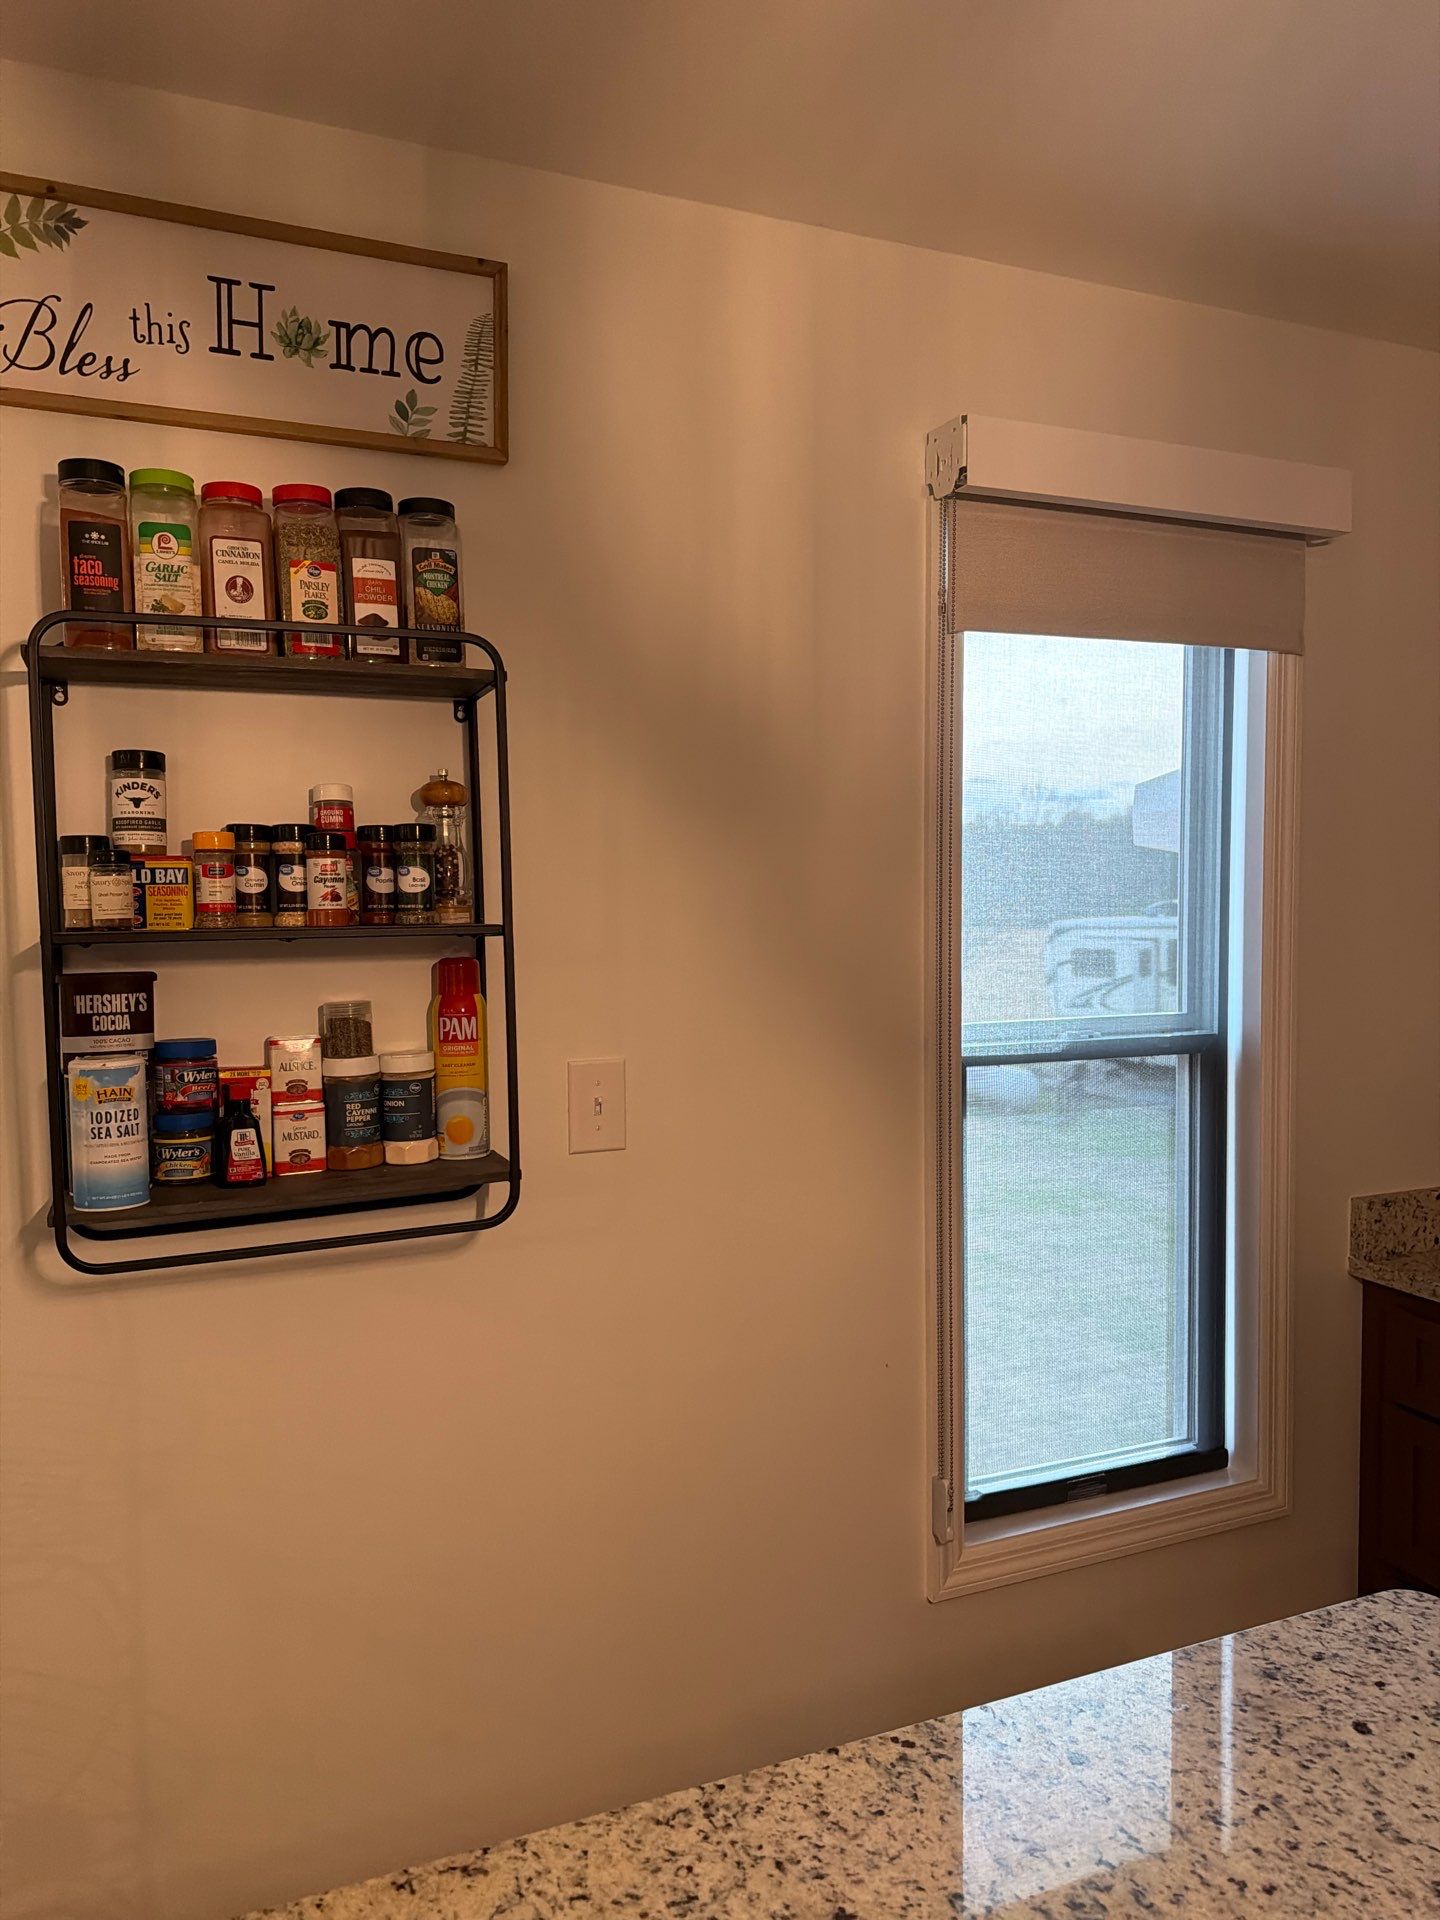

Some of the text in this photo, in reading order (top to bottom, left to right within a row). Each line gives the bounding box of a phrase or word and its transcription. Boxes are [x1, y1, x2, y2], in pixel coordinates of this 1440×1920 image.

[0, 294, 141, 382] Bless
[129, 303, 192, 355] this
[215, 548, 261, 560] CINNAMON
[72, 555, 103, 575] taco
[145, 560, 188, 575] GARLIC
[73, 574, 119, 592] seasoning
[154, 572, 180, 583] SALT
[299, 579, 330, 592] PARSLEY
[364, 585, 386, 594] CHILI
[304, 589, 327, 600] FLAKES
[357, 592, 393, 602] POWDER
[114, 781, 162, 800] KINDER'S
[320, 815, 344, 824] CUMIN
[132, 868, 185, 884] LD BAY
[313, 875, 345, 885] Cayenne
[148, 886, 188, 897] SEASONING
[74, 992, 148, 1015] HERSHEY'S
[92, 1014, 131, 1032] COCOA
[439, 1016, 477, 1041] PAM
[278, 1060, 314, 1073] ALLSPICE
[183, 1070, 217, 1083] Wyler's
[96, 1087, 133, 1099] HAIN
[345, 1102, 362, 1111] RED
[90, 1107, 139, 1125] IODIZED
[346, 1114, 372, 1123] PEPPER
[90, 1122, 140, 1140] SEA SALT
[281, 1129, 320, 1142] MUSTARD
[161, 1147, 200, 1160] Wyler's
[233, 1150, 255, 1158] Vanilla
